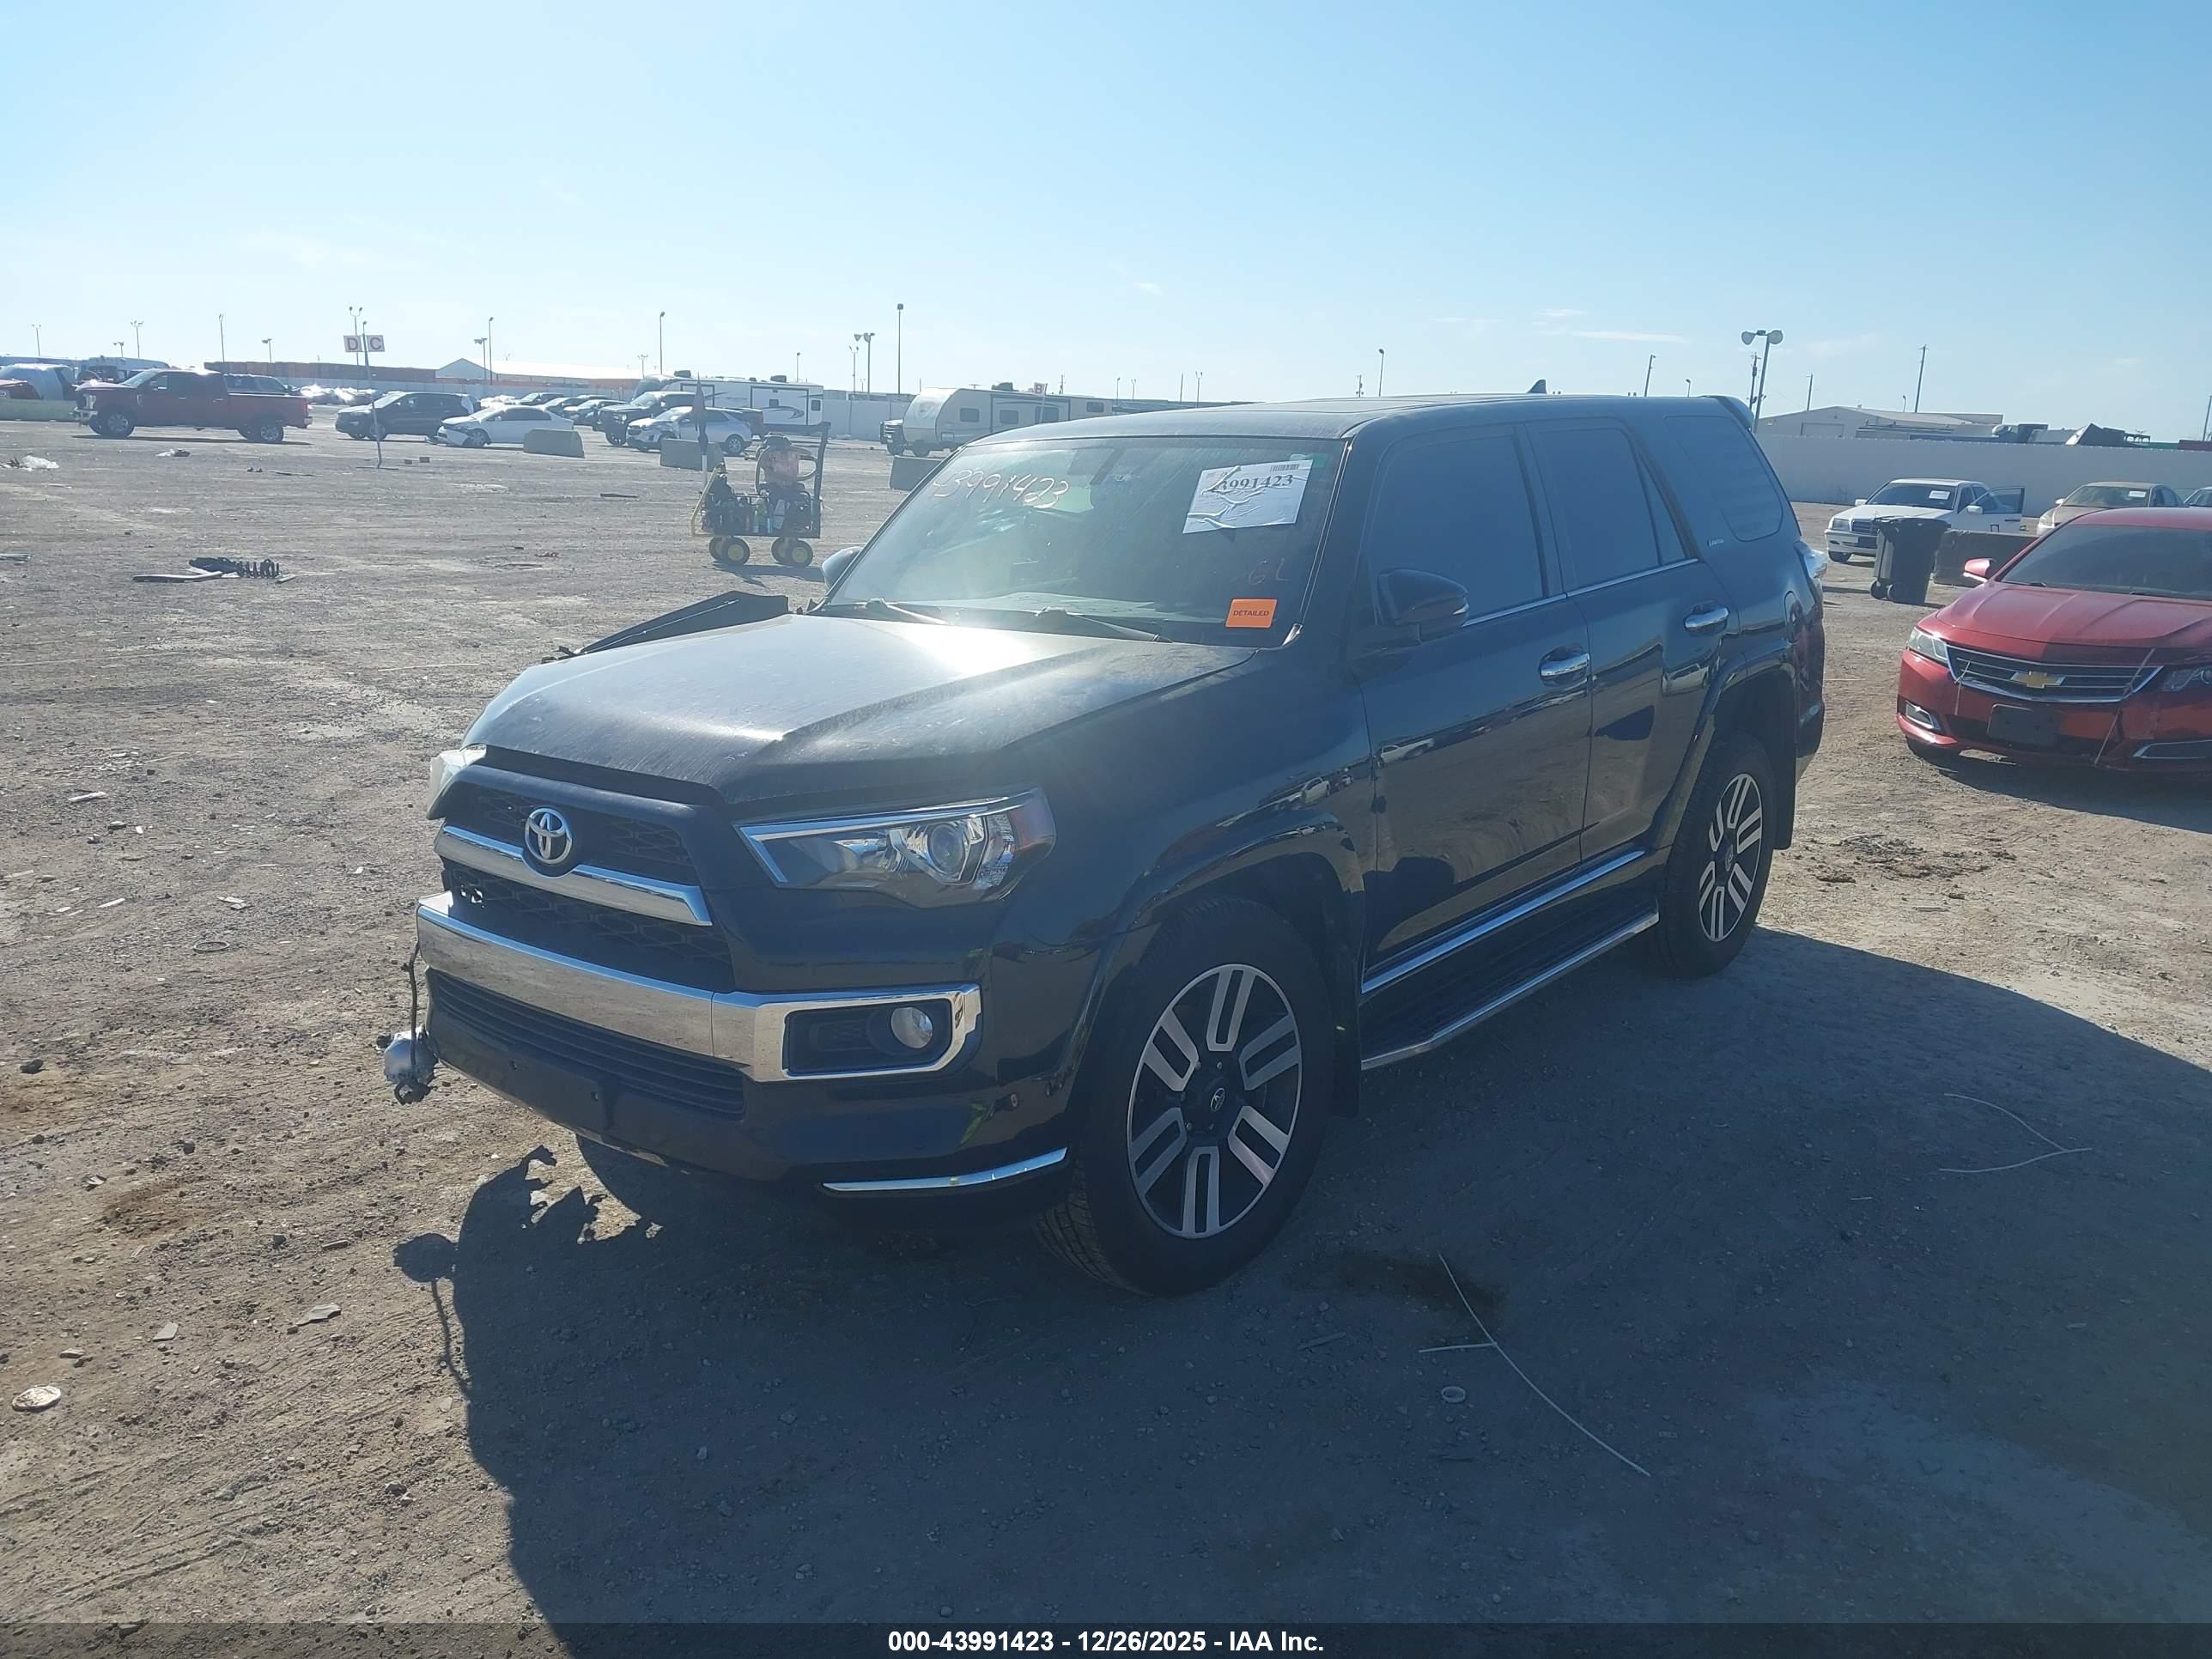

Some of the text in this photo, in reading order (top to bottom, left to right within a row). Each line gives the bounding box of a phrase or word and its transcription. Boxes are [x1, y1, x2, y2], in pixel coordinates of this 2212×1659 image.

[347, 337, 358, 351] D
[370, 337, 381, 350] C
[1211, 474, 1294, 490] 3991423
